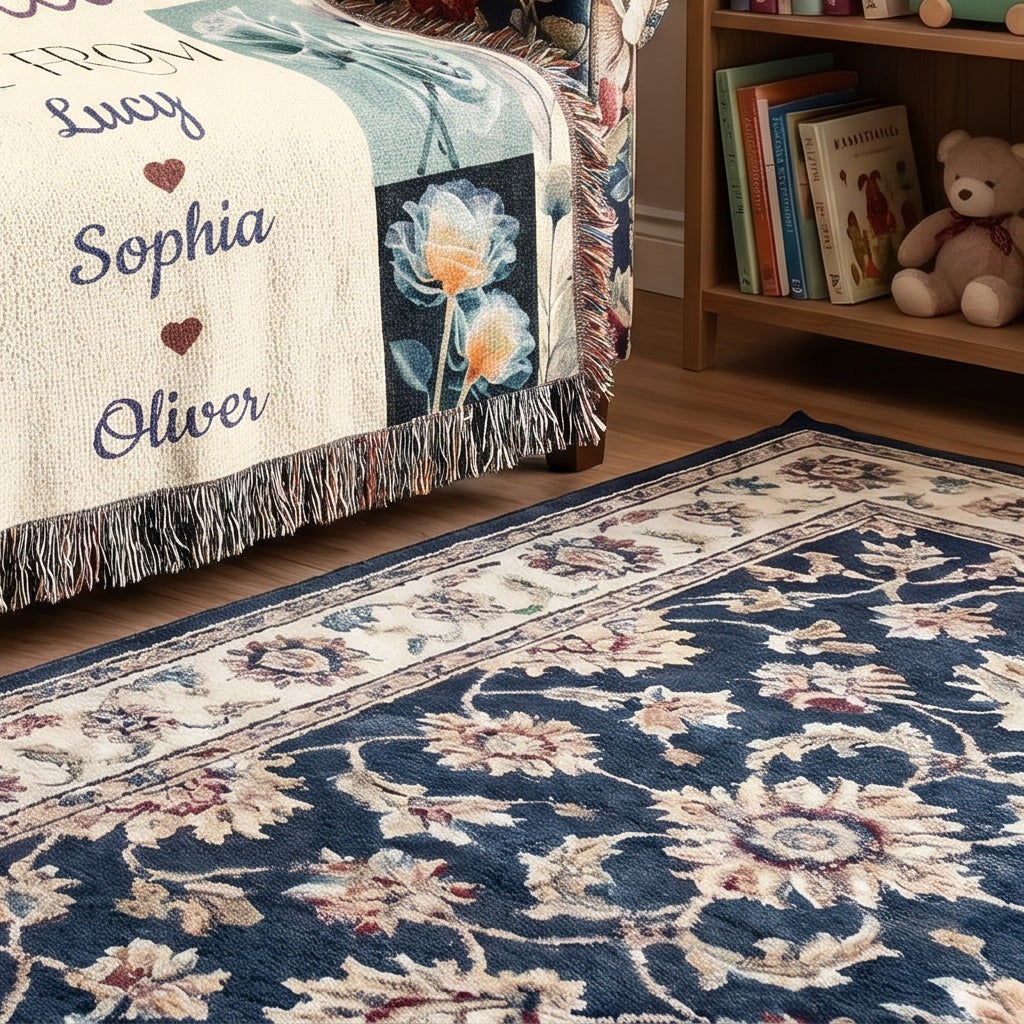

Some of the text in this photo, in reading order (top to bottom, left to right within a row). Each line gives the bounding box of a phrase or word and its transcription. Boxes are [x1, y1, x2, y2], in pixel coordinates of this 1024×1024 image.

[2, 39, 224, 76] FROM
[45, 90, 205, 141] Lucy
[69, 199, 275, 299] Sophia
[92, 386, 270, 460] Oliver
